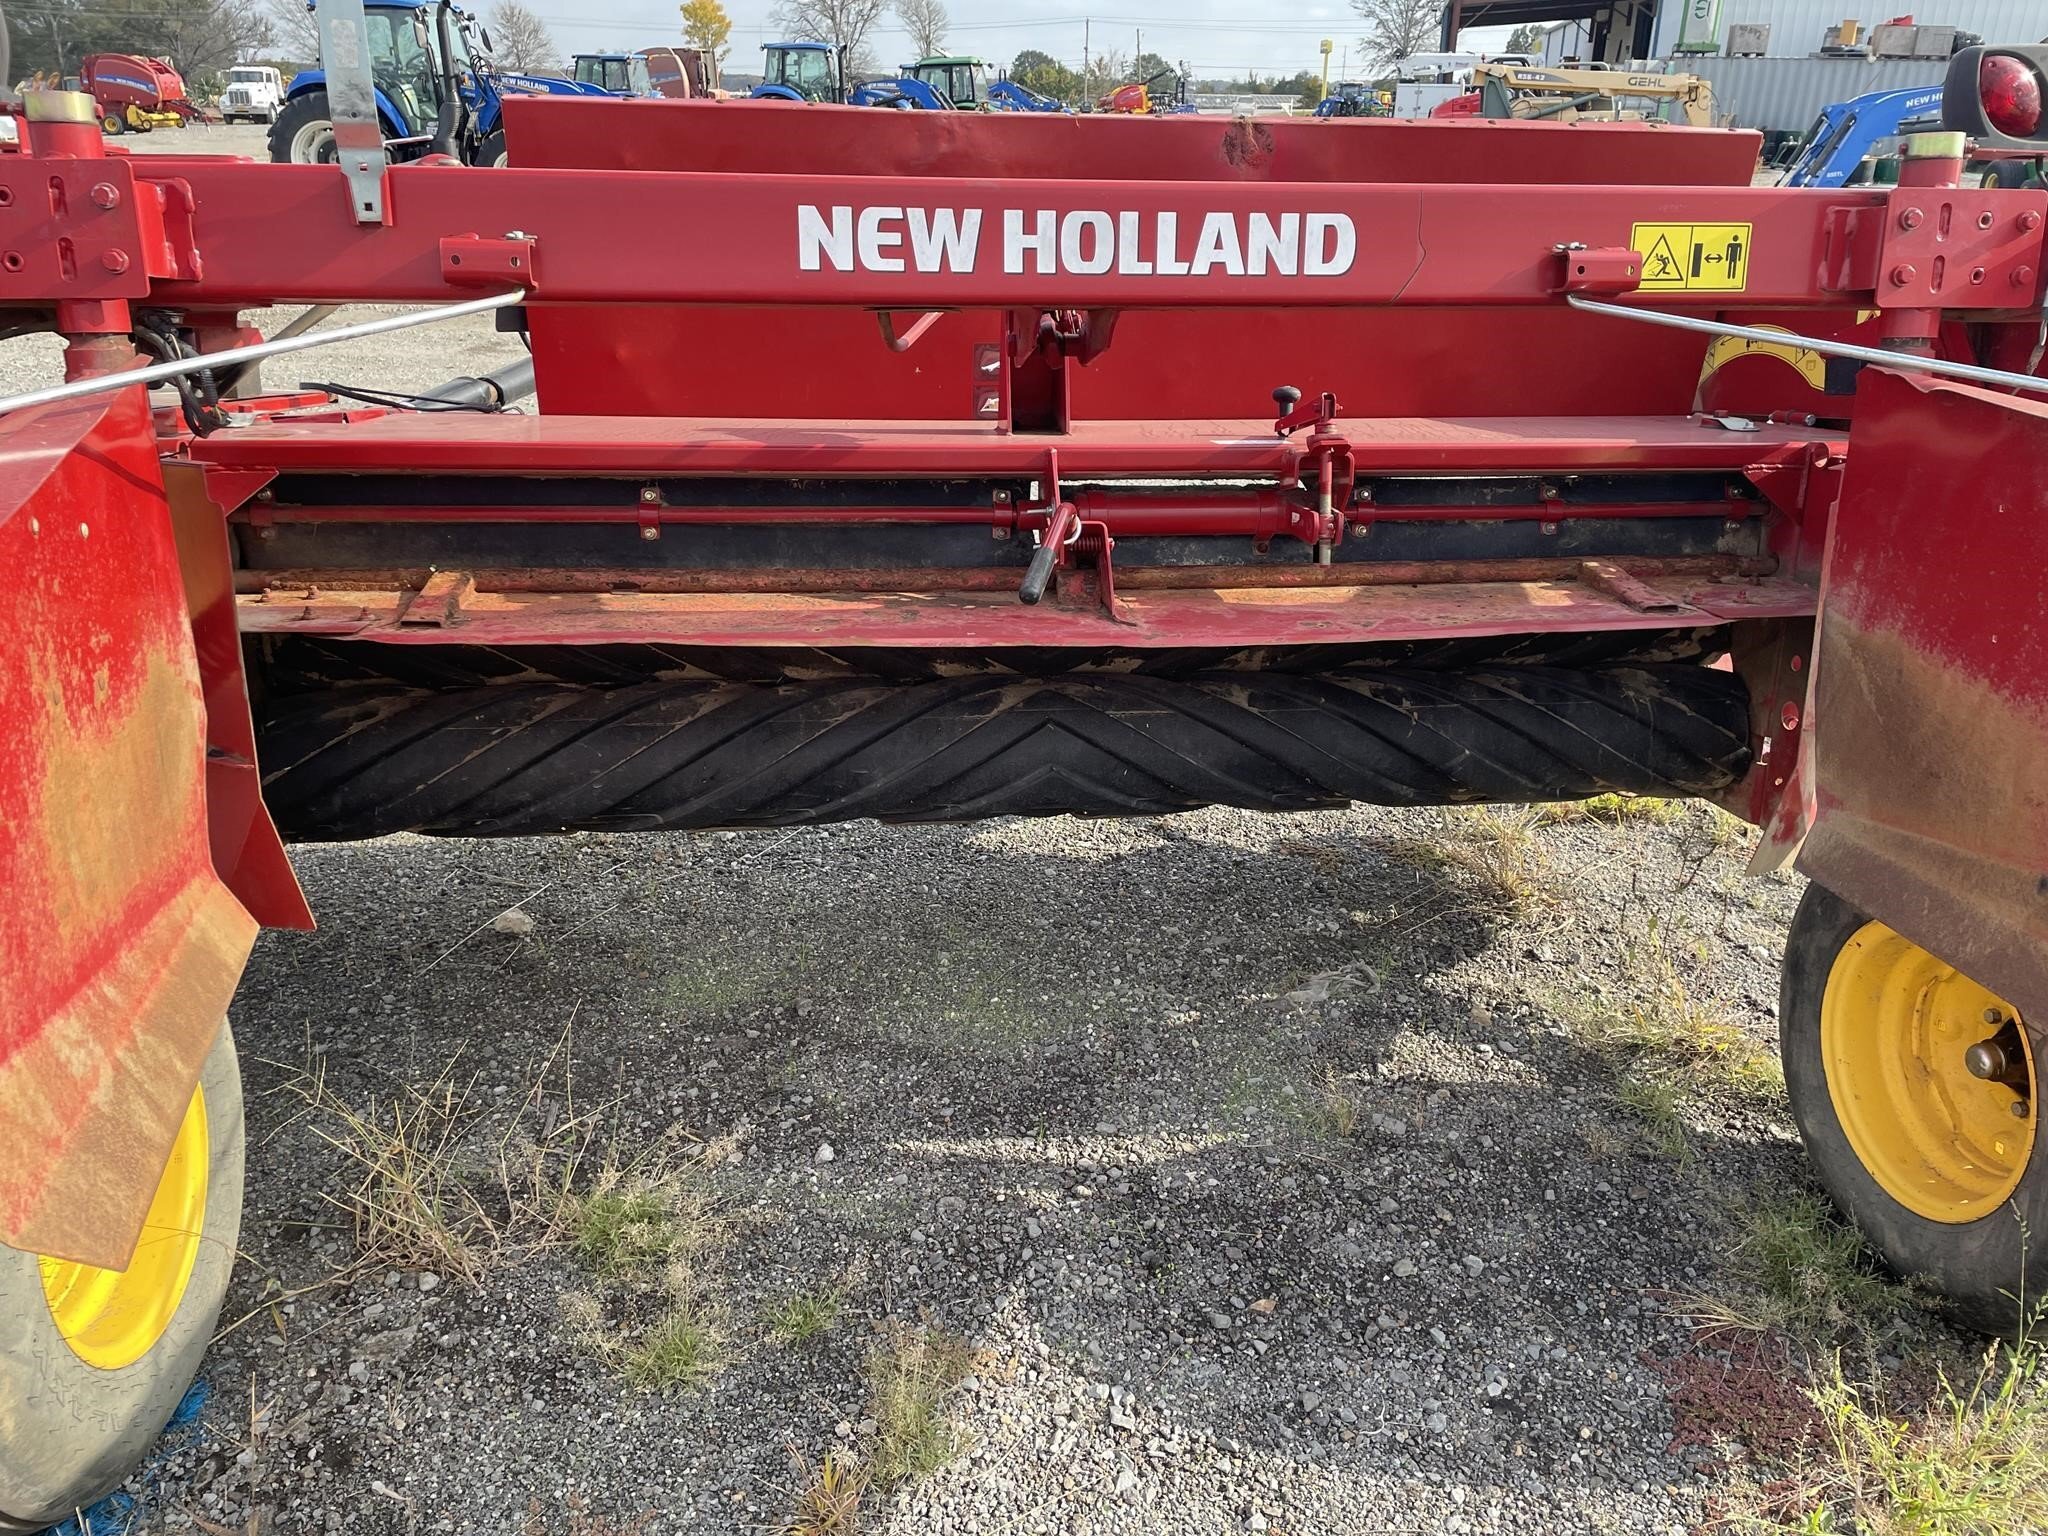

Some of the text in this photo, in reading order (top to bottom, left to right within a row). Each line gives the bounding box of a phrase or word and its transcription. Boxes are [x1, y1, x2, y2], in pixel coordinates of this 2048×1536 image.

[517, 79, 550, 93] HOLLAND
[1628, 76, 1666, 88] GEHL
[1906, 94, 1931, 108] NEW
[797, 204, 1357, 276] NEW HOLLAND
